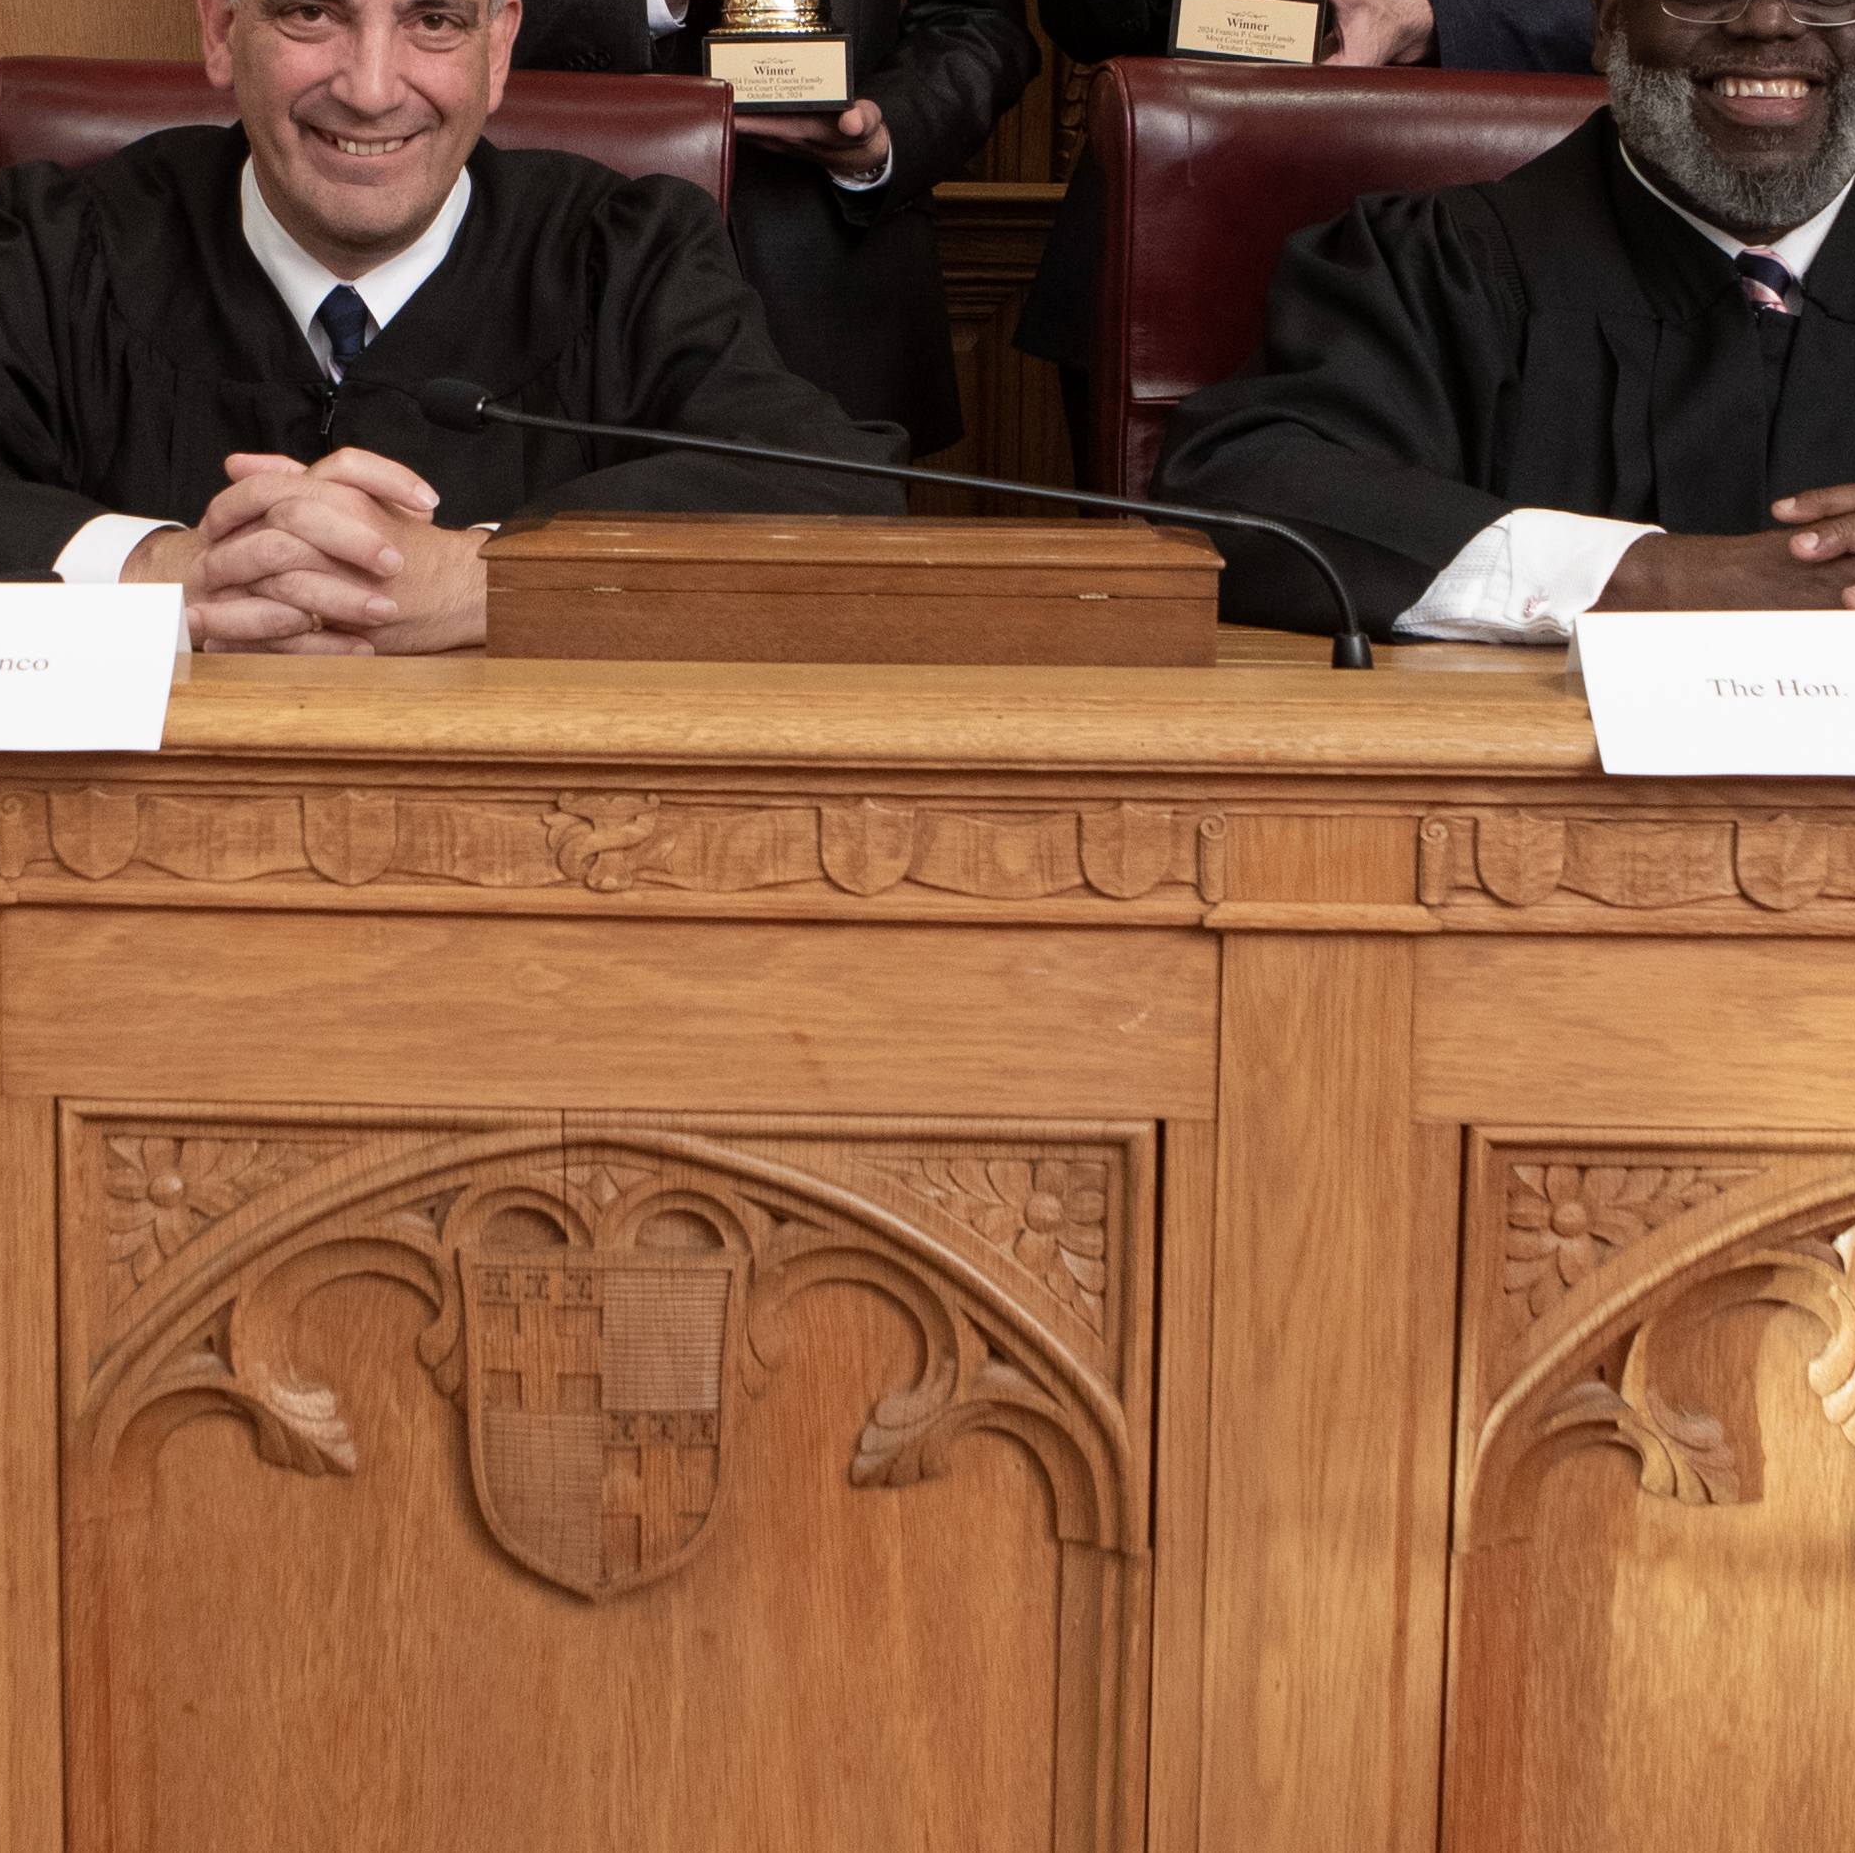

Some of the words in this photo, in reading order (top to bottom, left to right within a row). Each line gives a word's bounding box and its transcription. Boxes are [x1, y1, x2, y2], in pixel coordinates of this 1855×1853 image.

[1227, 17, 1269, 32] Winner
[754, 66, 795, 75] Winner
[1706, 678, 1765, 697] The
[1776, 678, 1848, 698] Hon.
